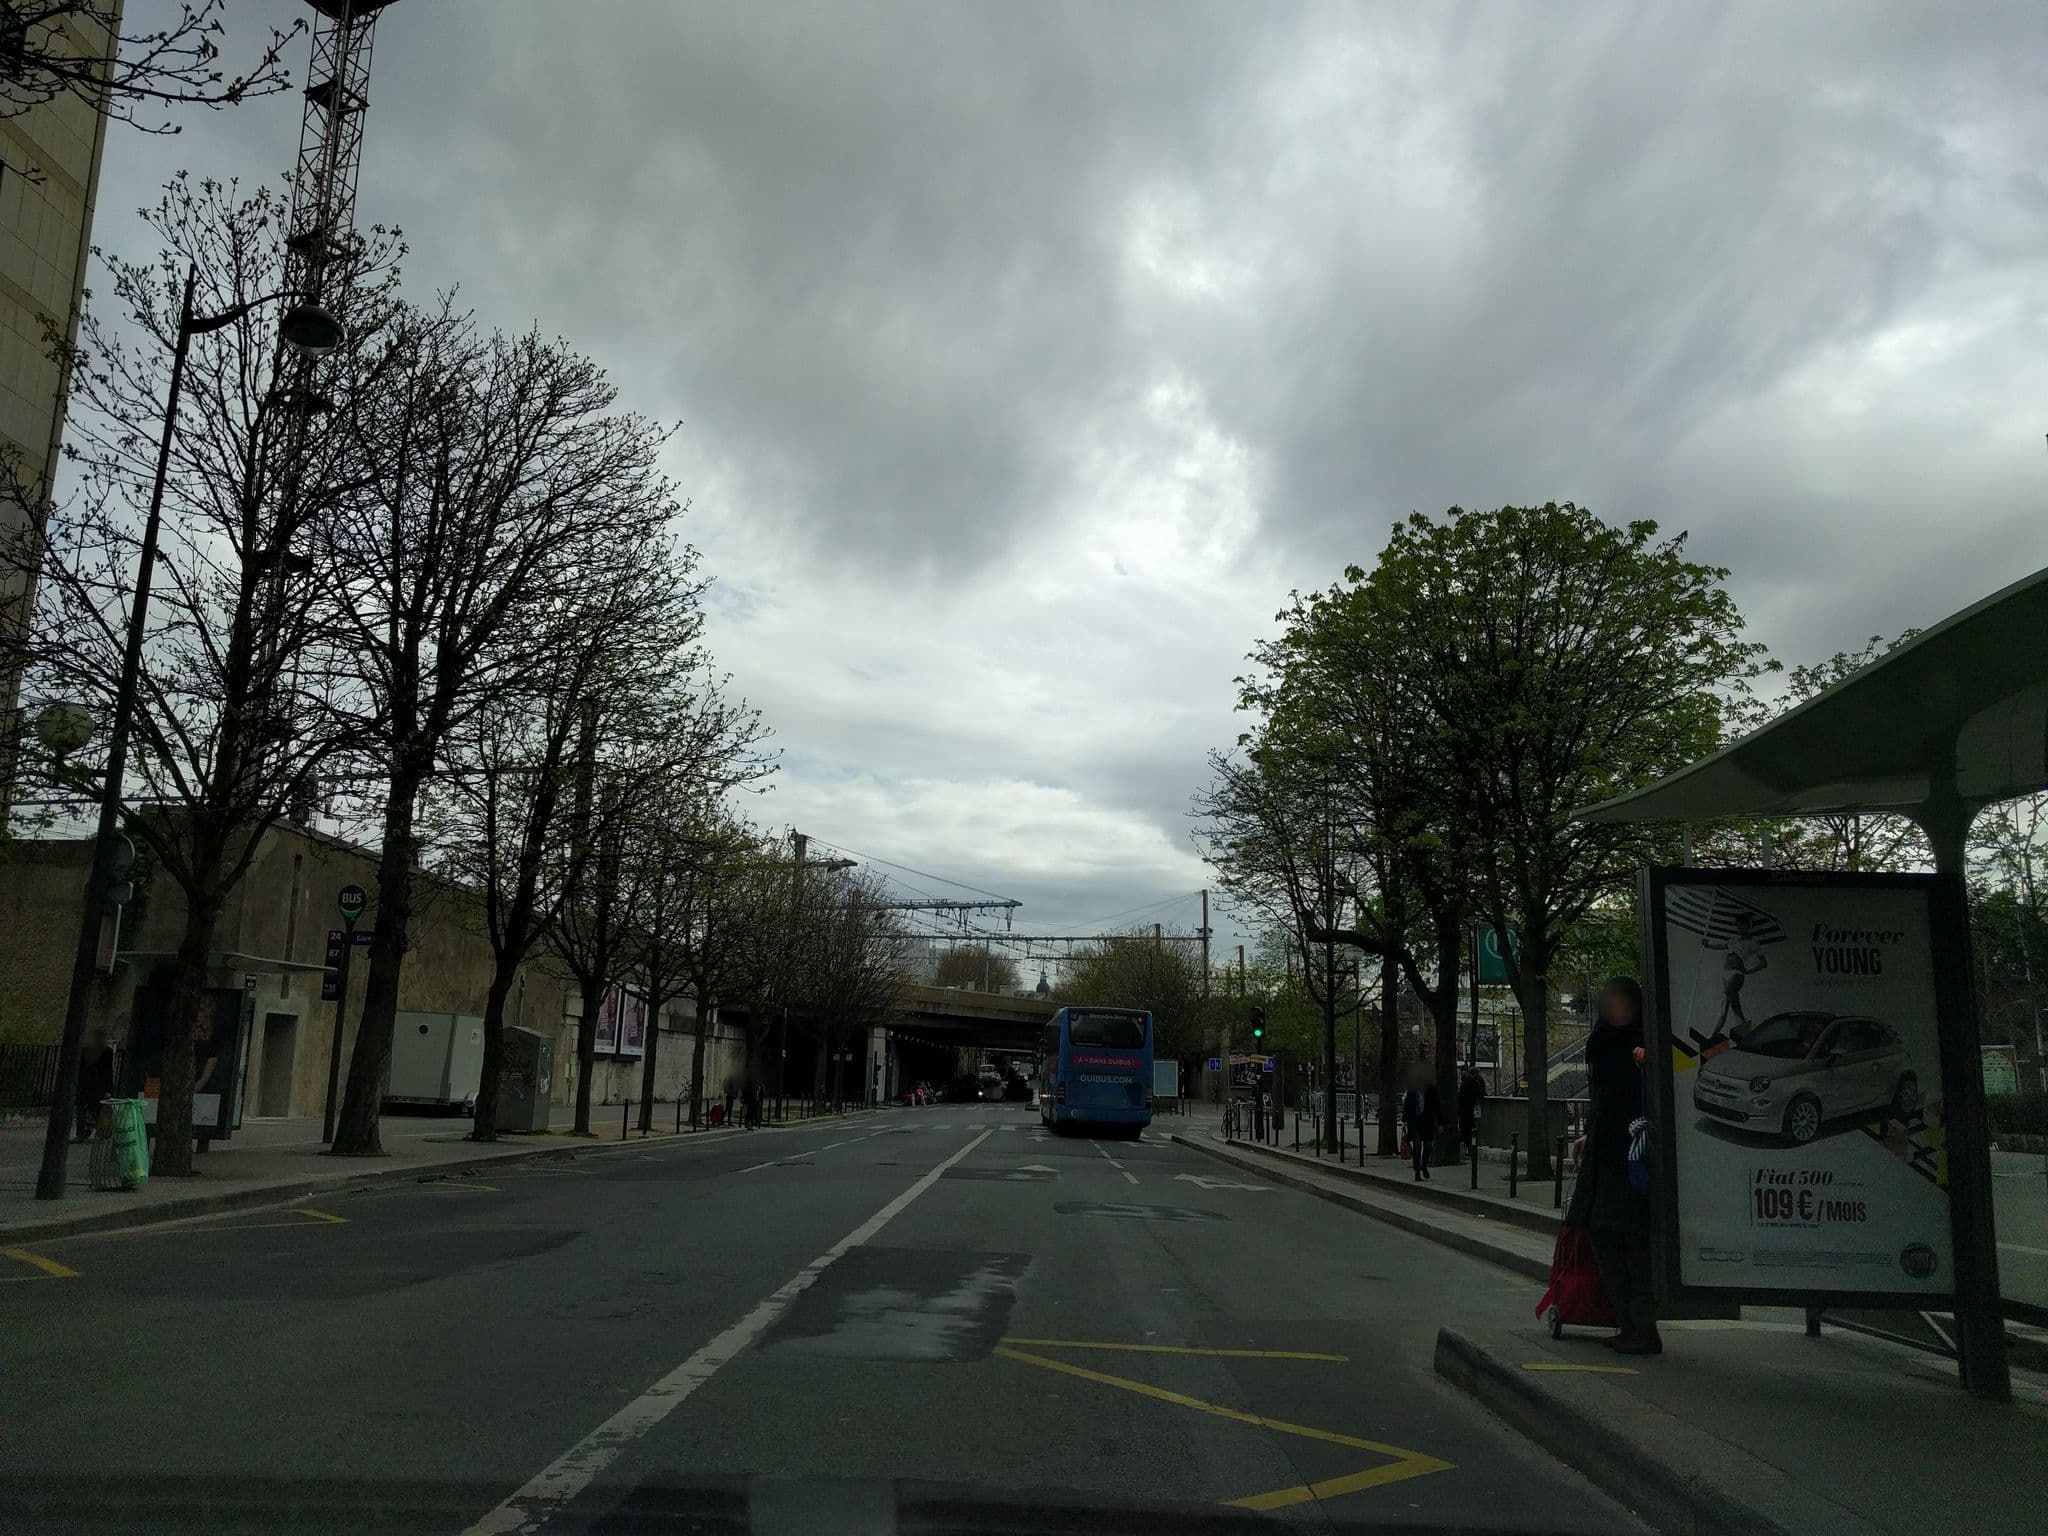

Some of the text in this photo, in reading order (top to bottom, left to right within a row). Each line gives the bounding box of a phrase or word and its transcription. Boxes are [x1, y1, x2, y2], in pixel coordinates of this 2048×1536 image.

[342, 893, 362, 904] BUS
[1812, 923, 1904, 944] Forever
[1812, 946, 1882, 975] YOUNG
[1080, 1074, 1132, 1084] OUIBUS.COM
[1754, 1168, 1834, 1186] Fiat 500
[1754, 1188, 1794, 1219] 109
